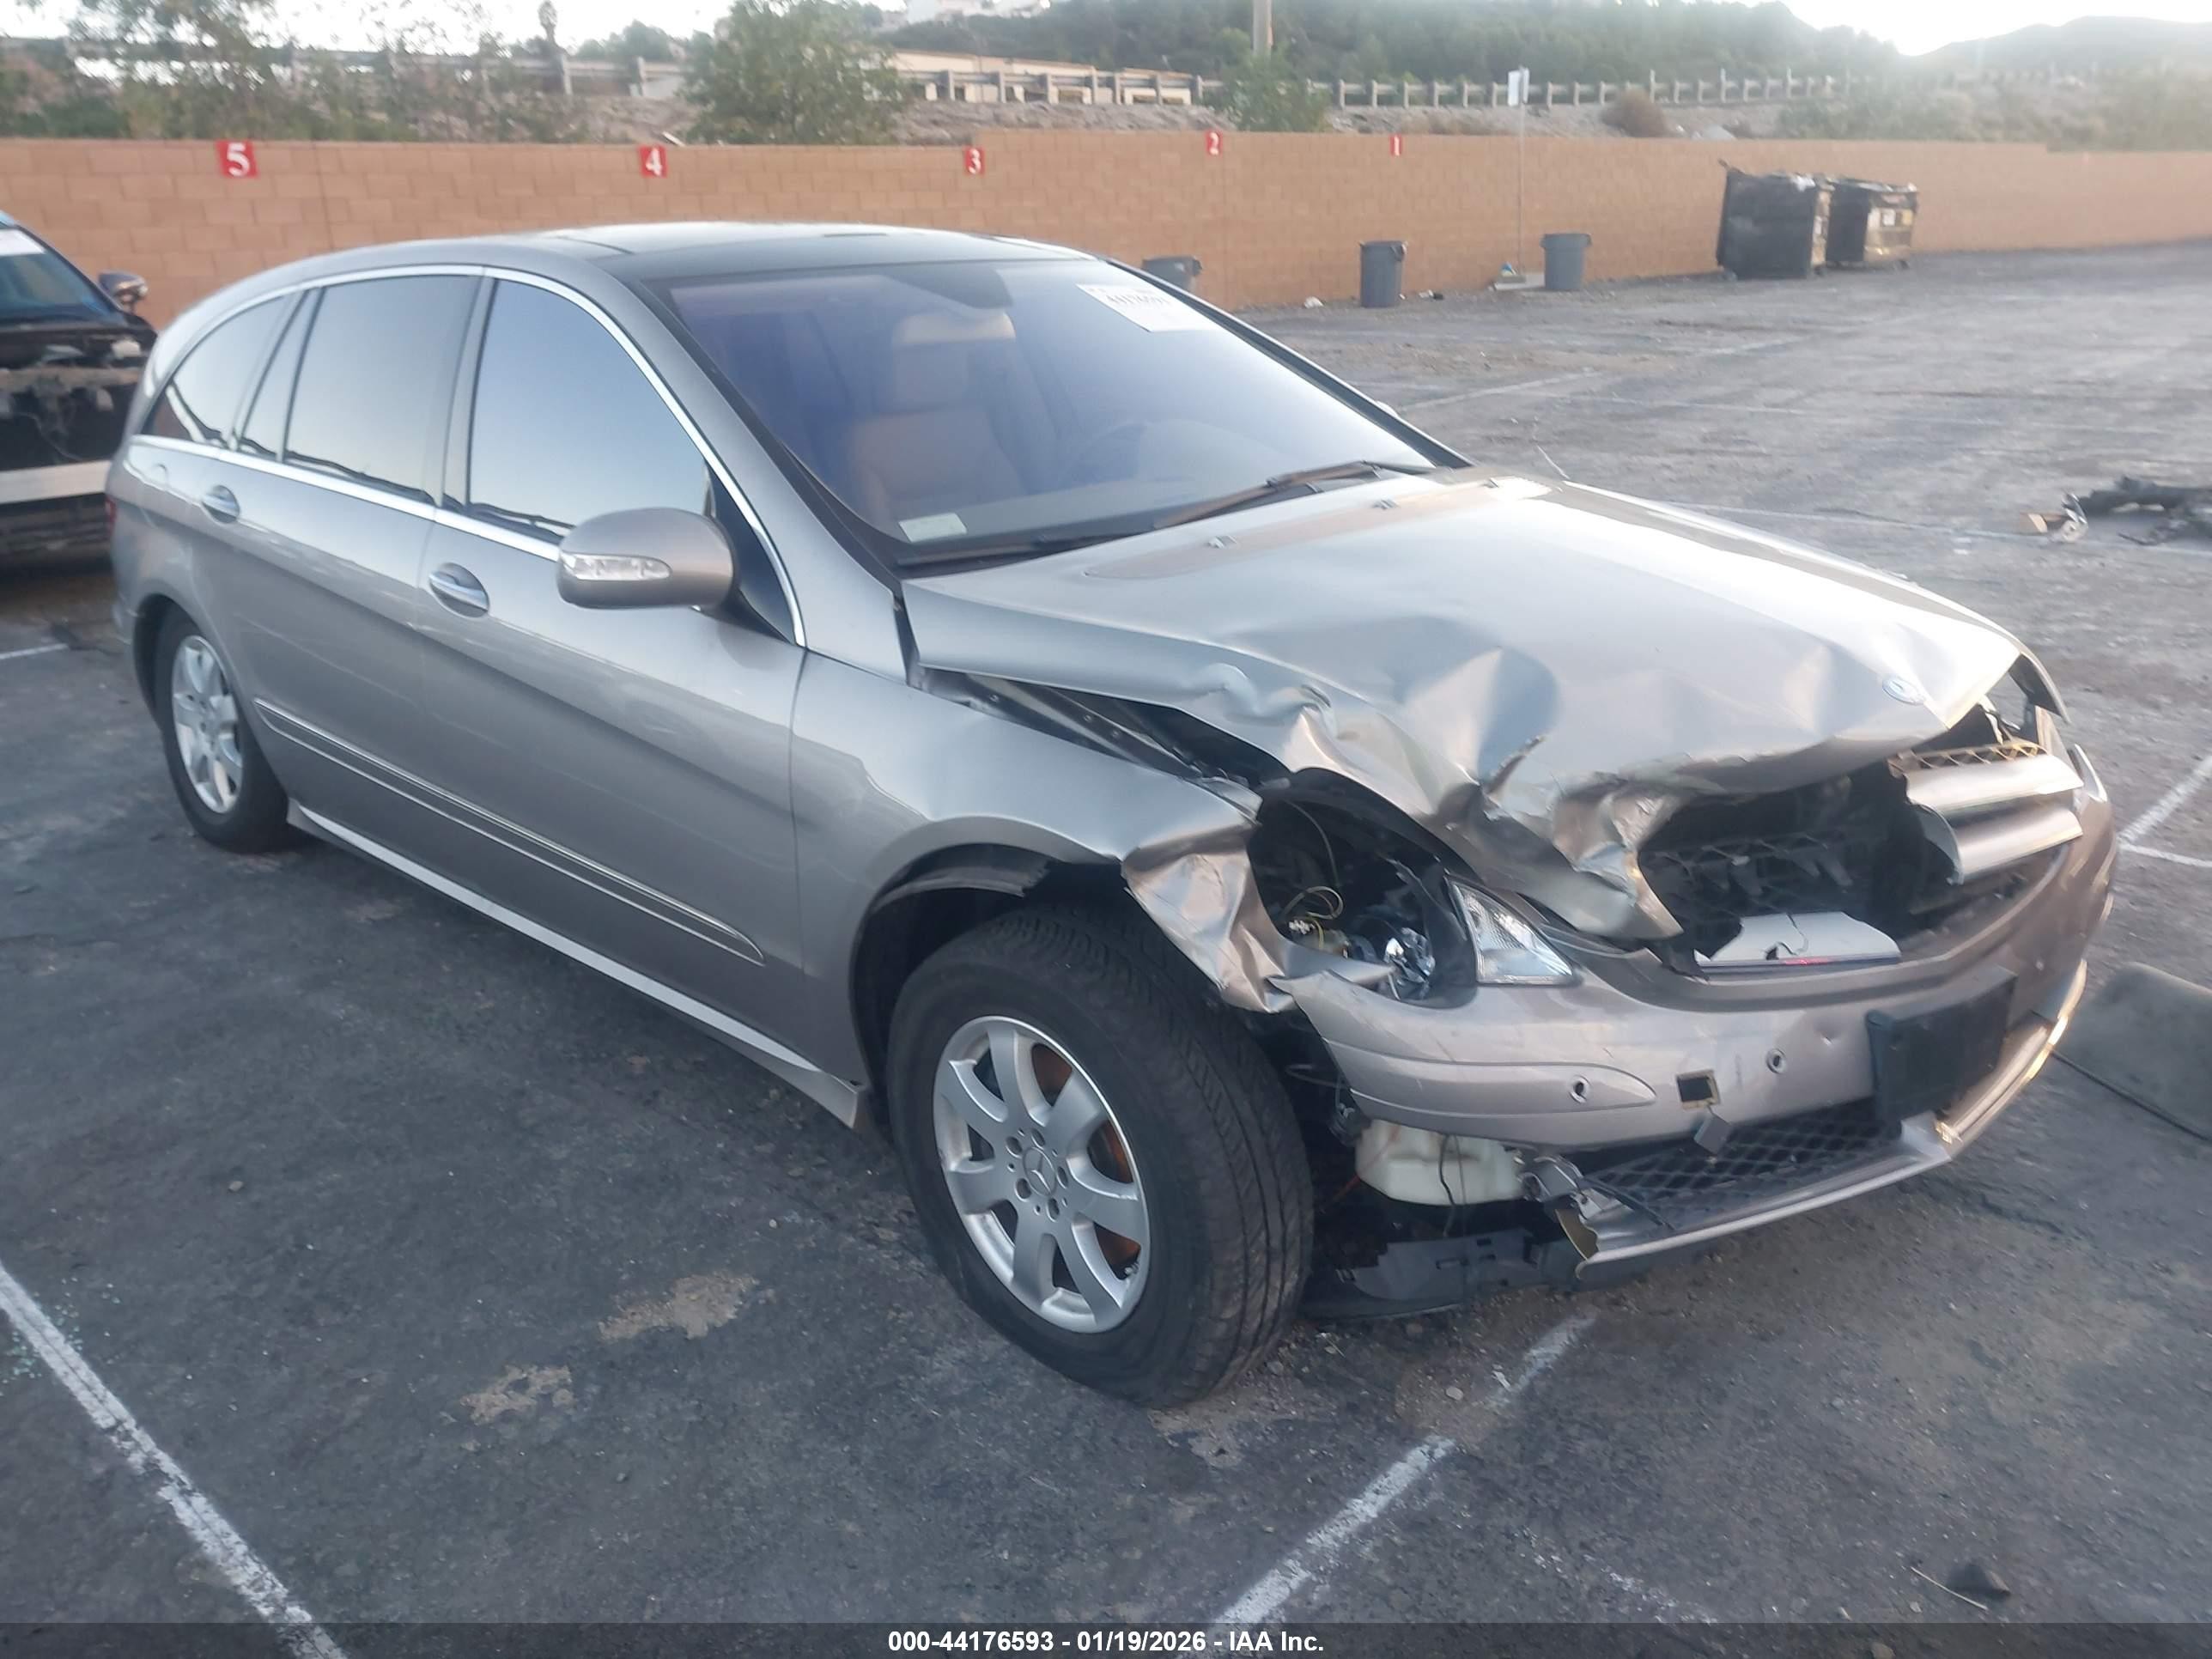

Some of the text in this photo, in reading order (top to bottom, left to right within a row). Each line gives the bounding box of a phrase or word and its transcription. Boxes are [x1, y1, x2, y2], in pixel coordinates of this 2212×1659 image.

[1209, 131, 1219, 155] 2
[227, 143, 250, 176] 5
[646, 148, 662, 176] 4
[969, 148, 981, 174] 3
